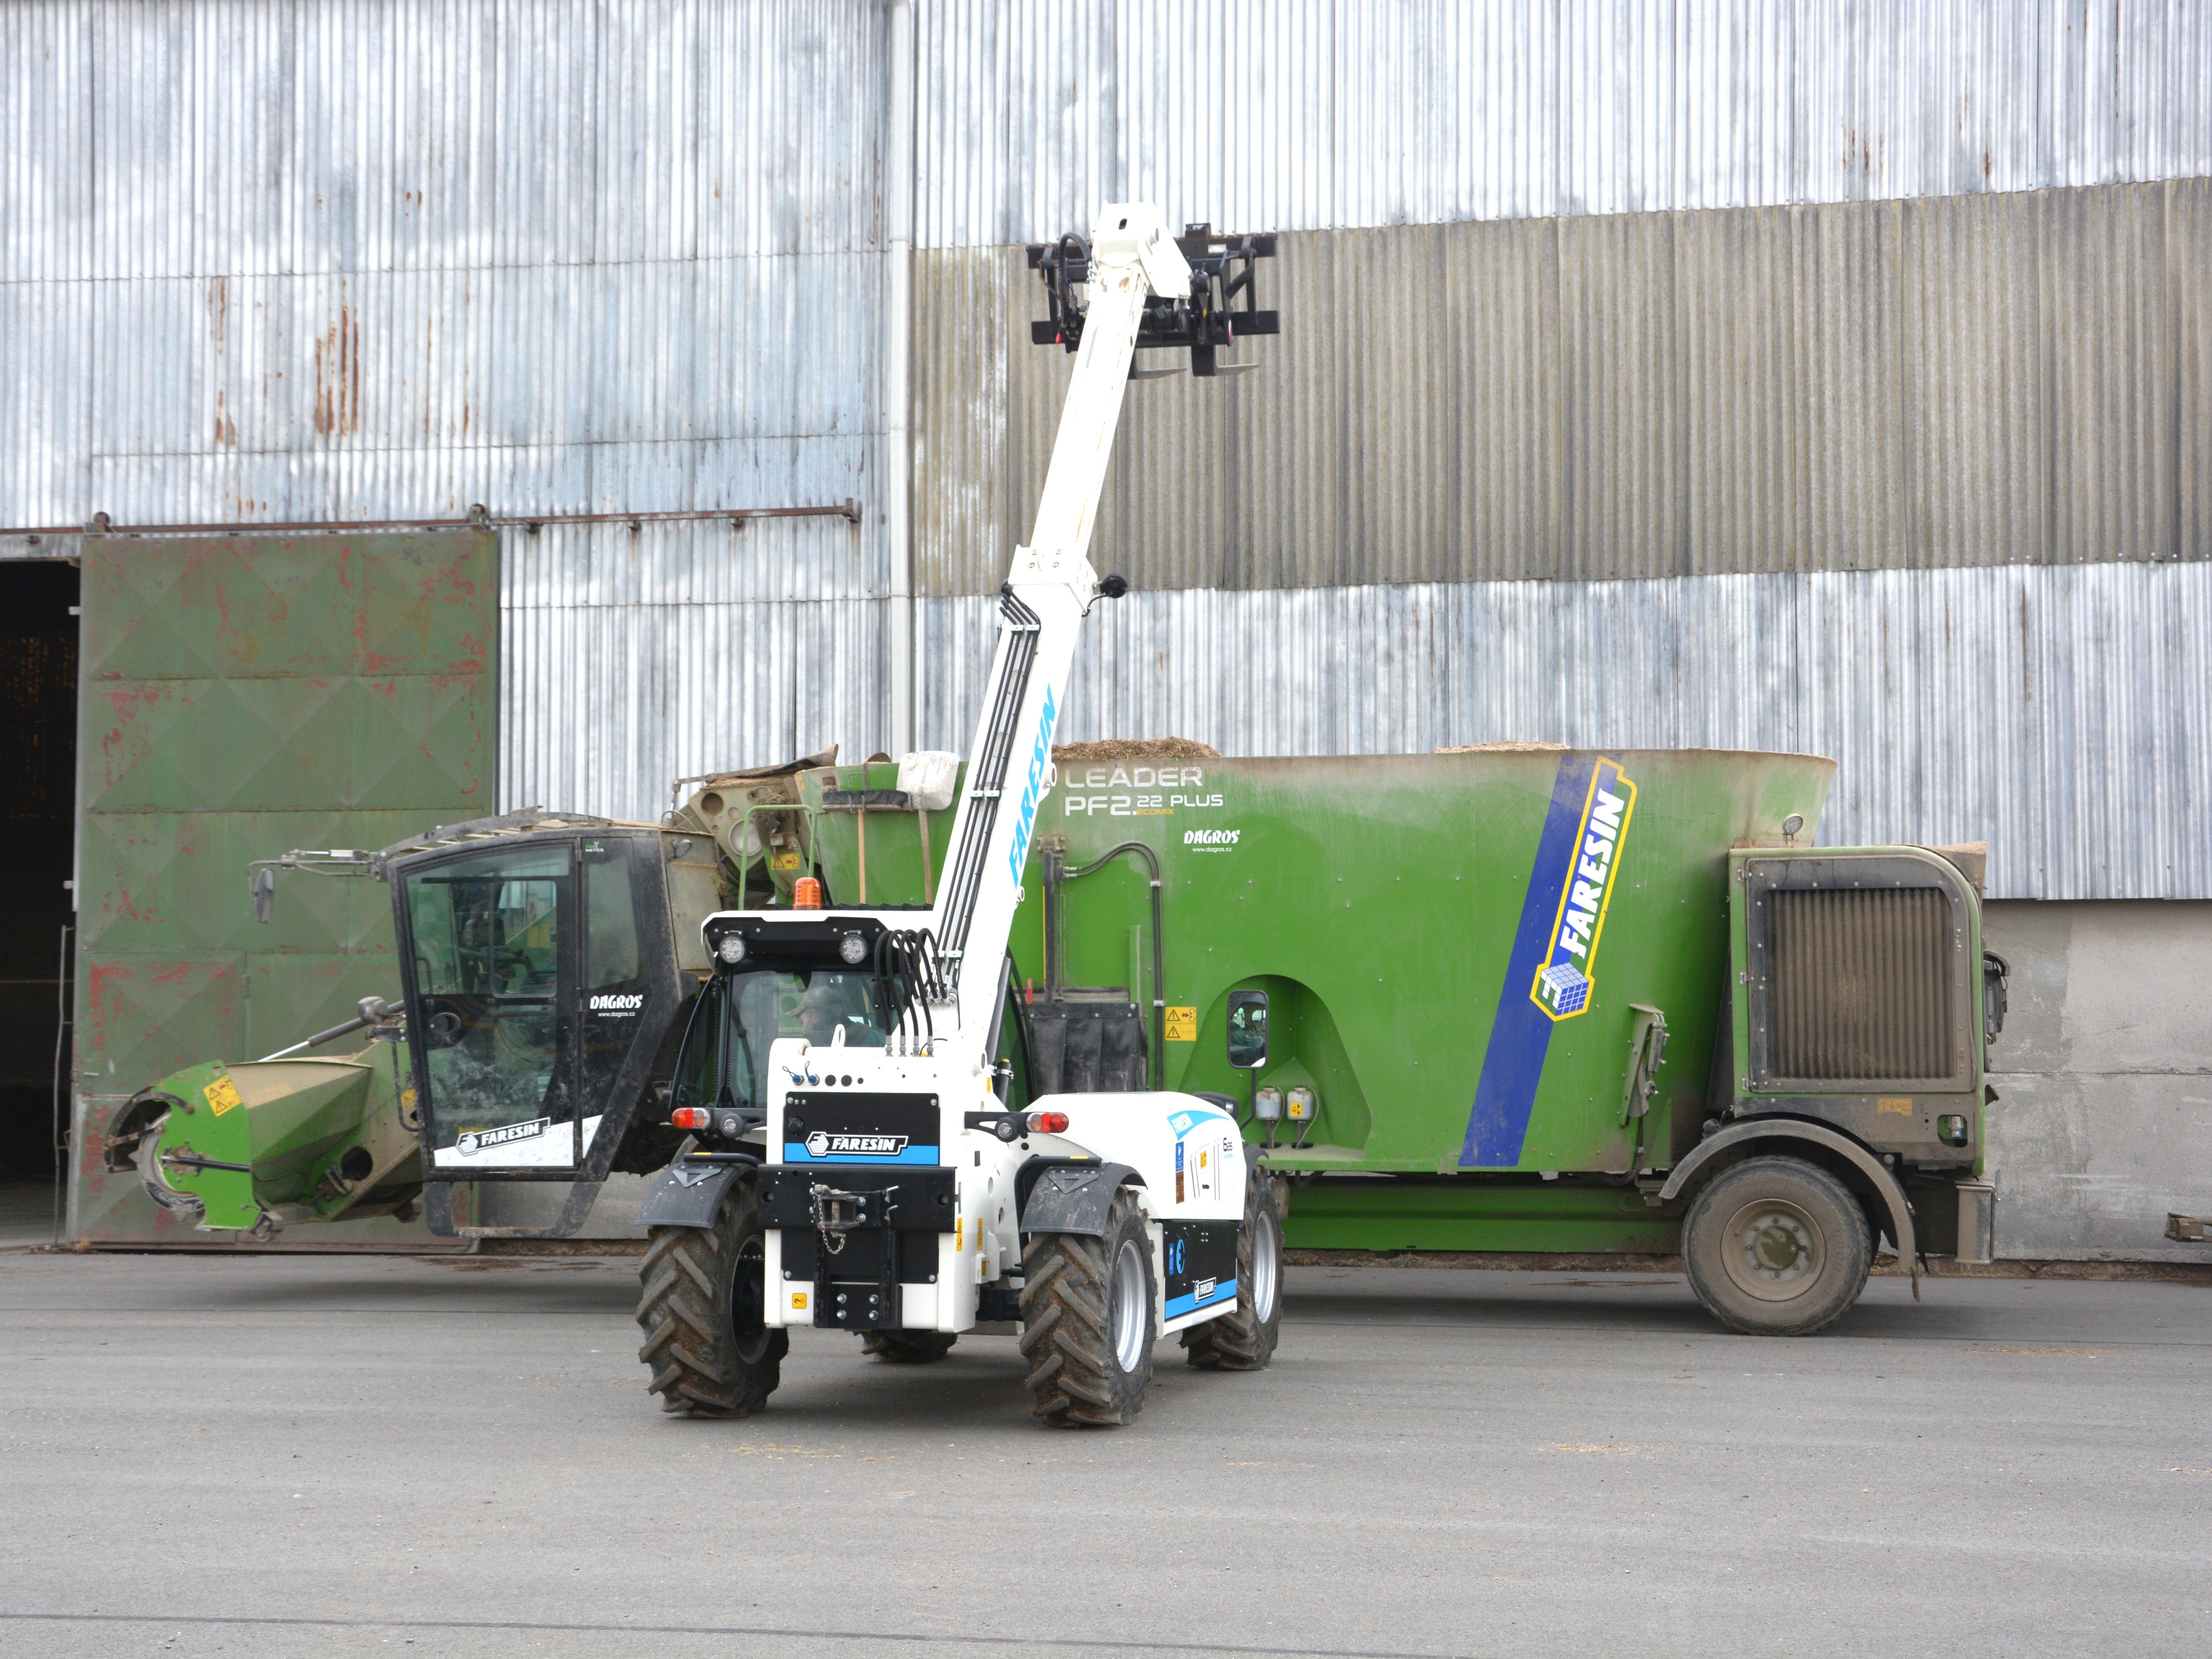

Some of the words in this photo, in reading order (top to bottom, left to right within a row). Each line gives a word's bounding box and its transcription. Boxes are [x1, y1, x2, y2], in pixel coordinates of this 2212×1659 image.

[1065, 766, 1202, 788] LEADER
[1009, 683, 1056, 890] FARESIN
[1170, 795, 1223, 807] PLUS
[1184, 830, 1240, 844] DAGROS
[1560, 788, 1625, 959] FARESIN
[590, 995, 642, 1009] DAGROS
[481, 1122, 539, 1146] FARESIN
[832, 1138, 896, 1151] FARESIN
[1200, 1281, 1214, 1295] FARESIN
